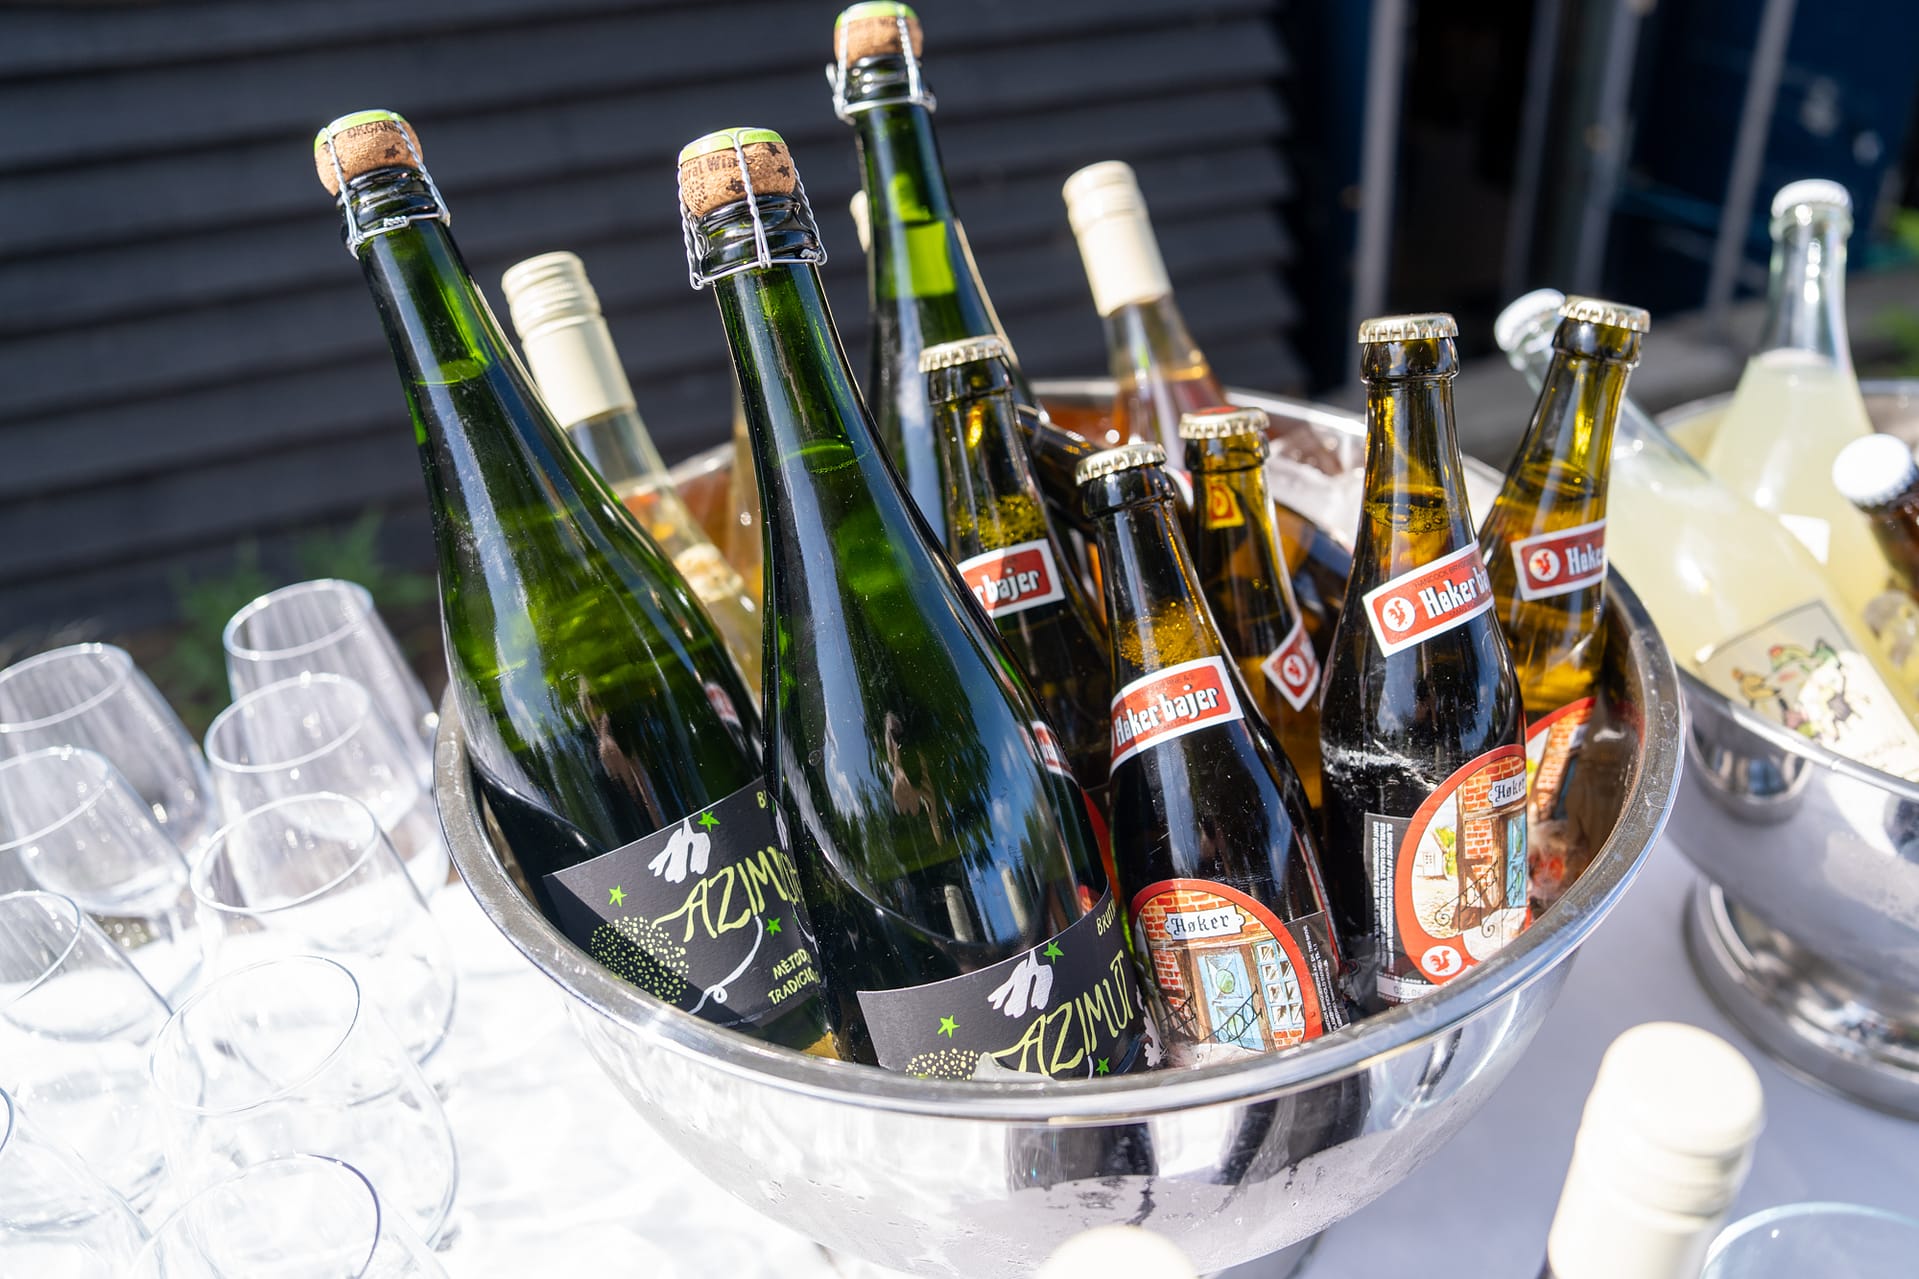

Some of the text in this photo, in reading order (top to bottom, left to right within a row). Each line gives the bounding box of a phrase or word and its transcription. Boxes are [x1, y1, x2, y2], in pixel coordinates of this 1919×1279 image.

[981, 567, 1041, 604] bajer
[1158, 683, 1220, 722] bajer
[1170, 912, 1230, 936] Høker
[992, 949, 1134, 1075] AZIMUT
